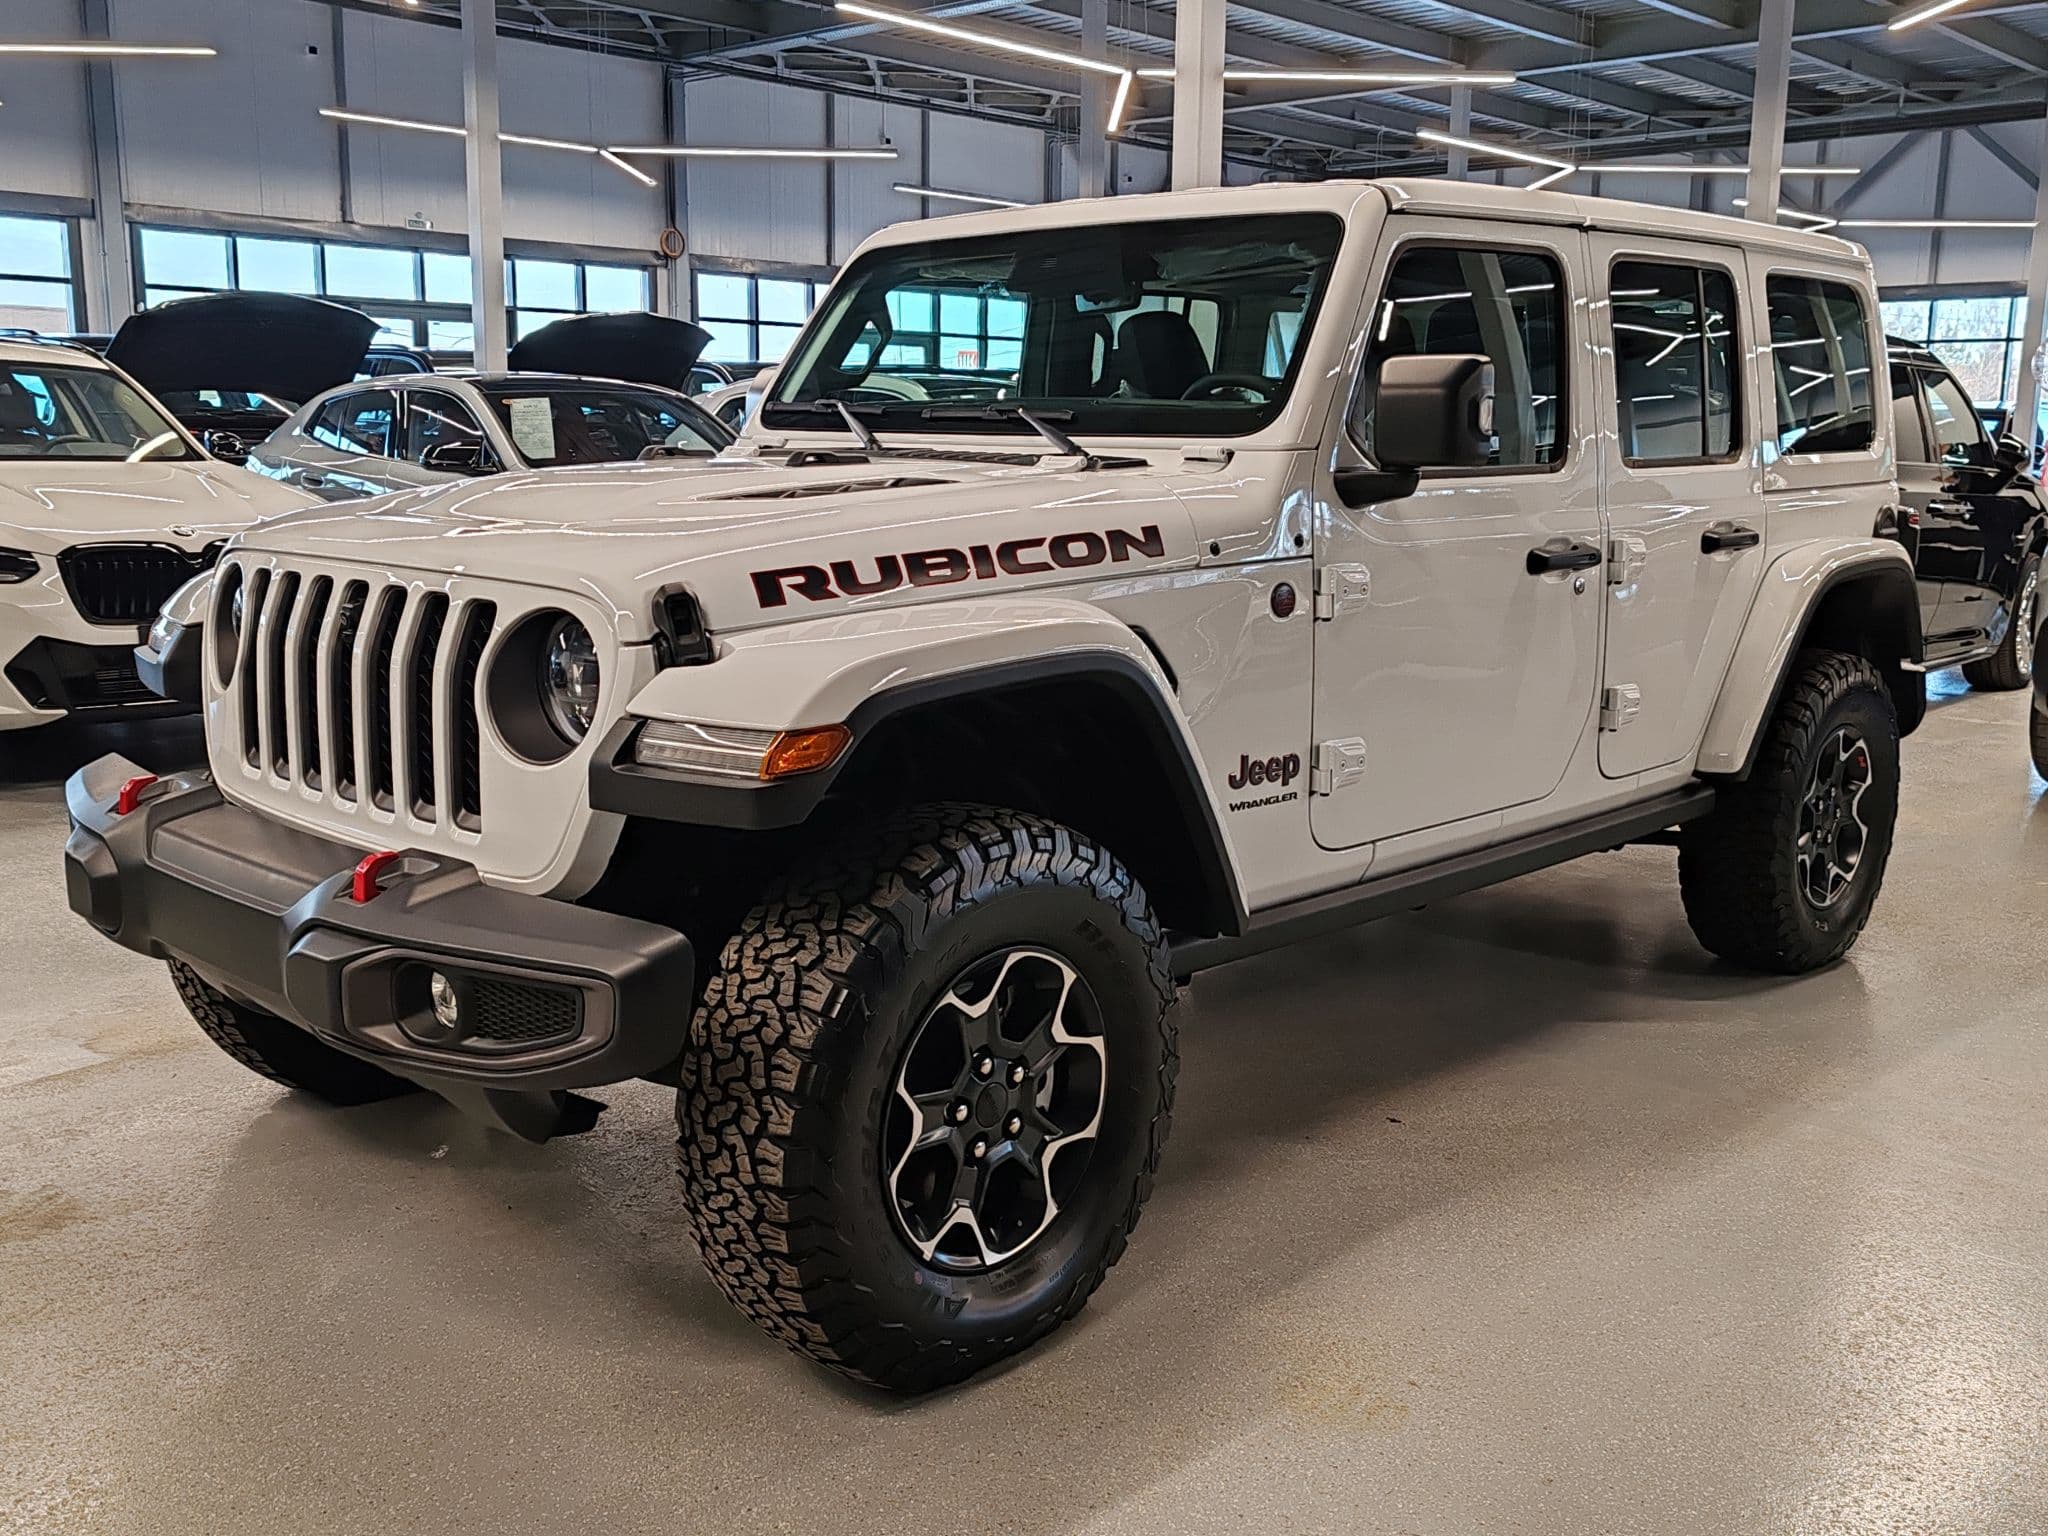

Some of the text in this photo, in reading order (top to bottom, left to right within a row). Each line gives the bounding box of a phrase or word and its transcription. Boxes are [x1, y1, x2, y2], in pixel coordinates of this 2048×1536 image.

[749, 525, 1165, 608] RUBICON
[1228, 753, 1300, 789] Jeep
[1229, 792, 1298, 812] WRANGLER
